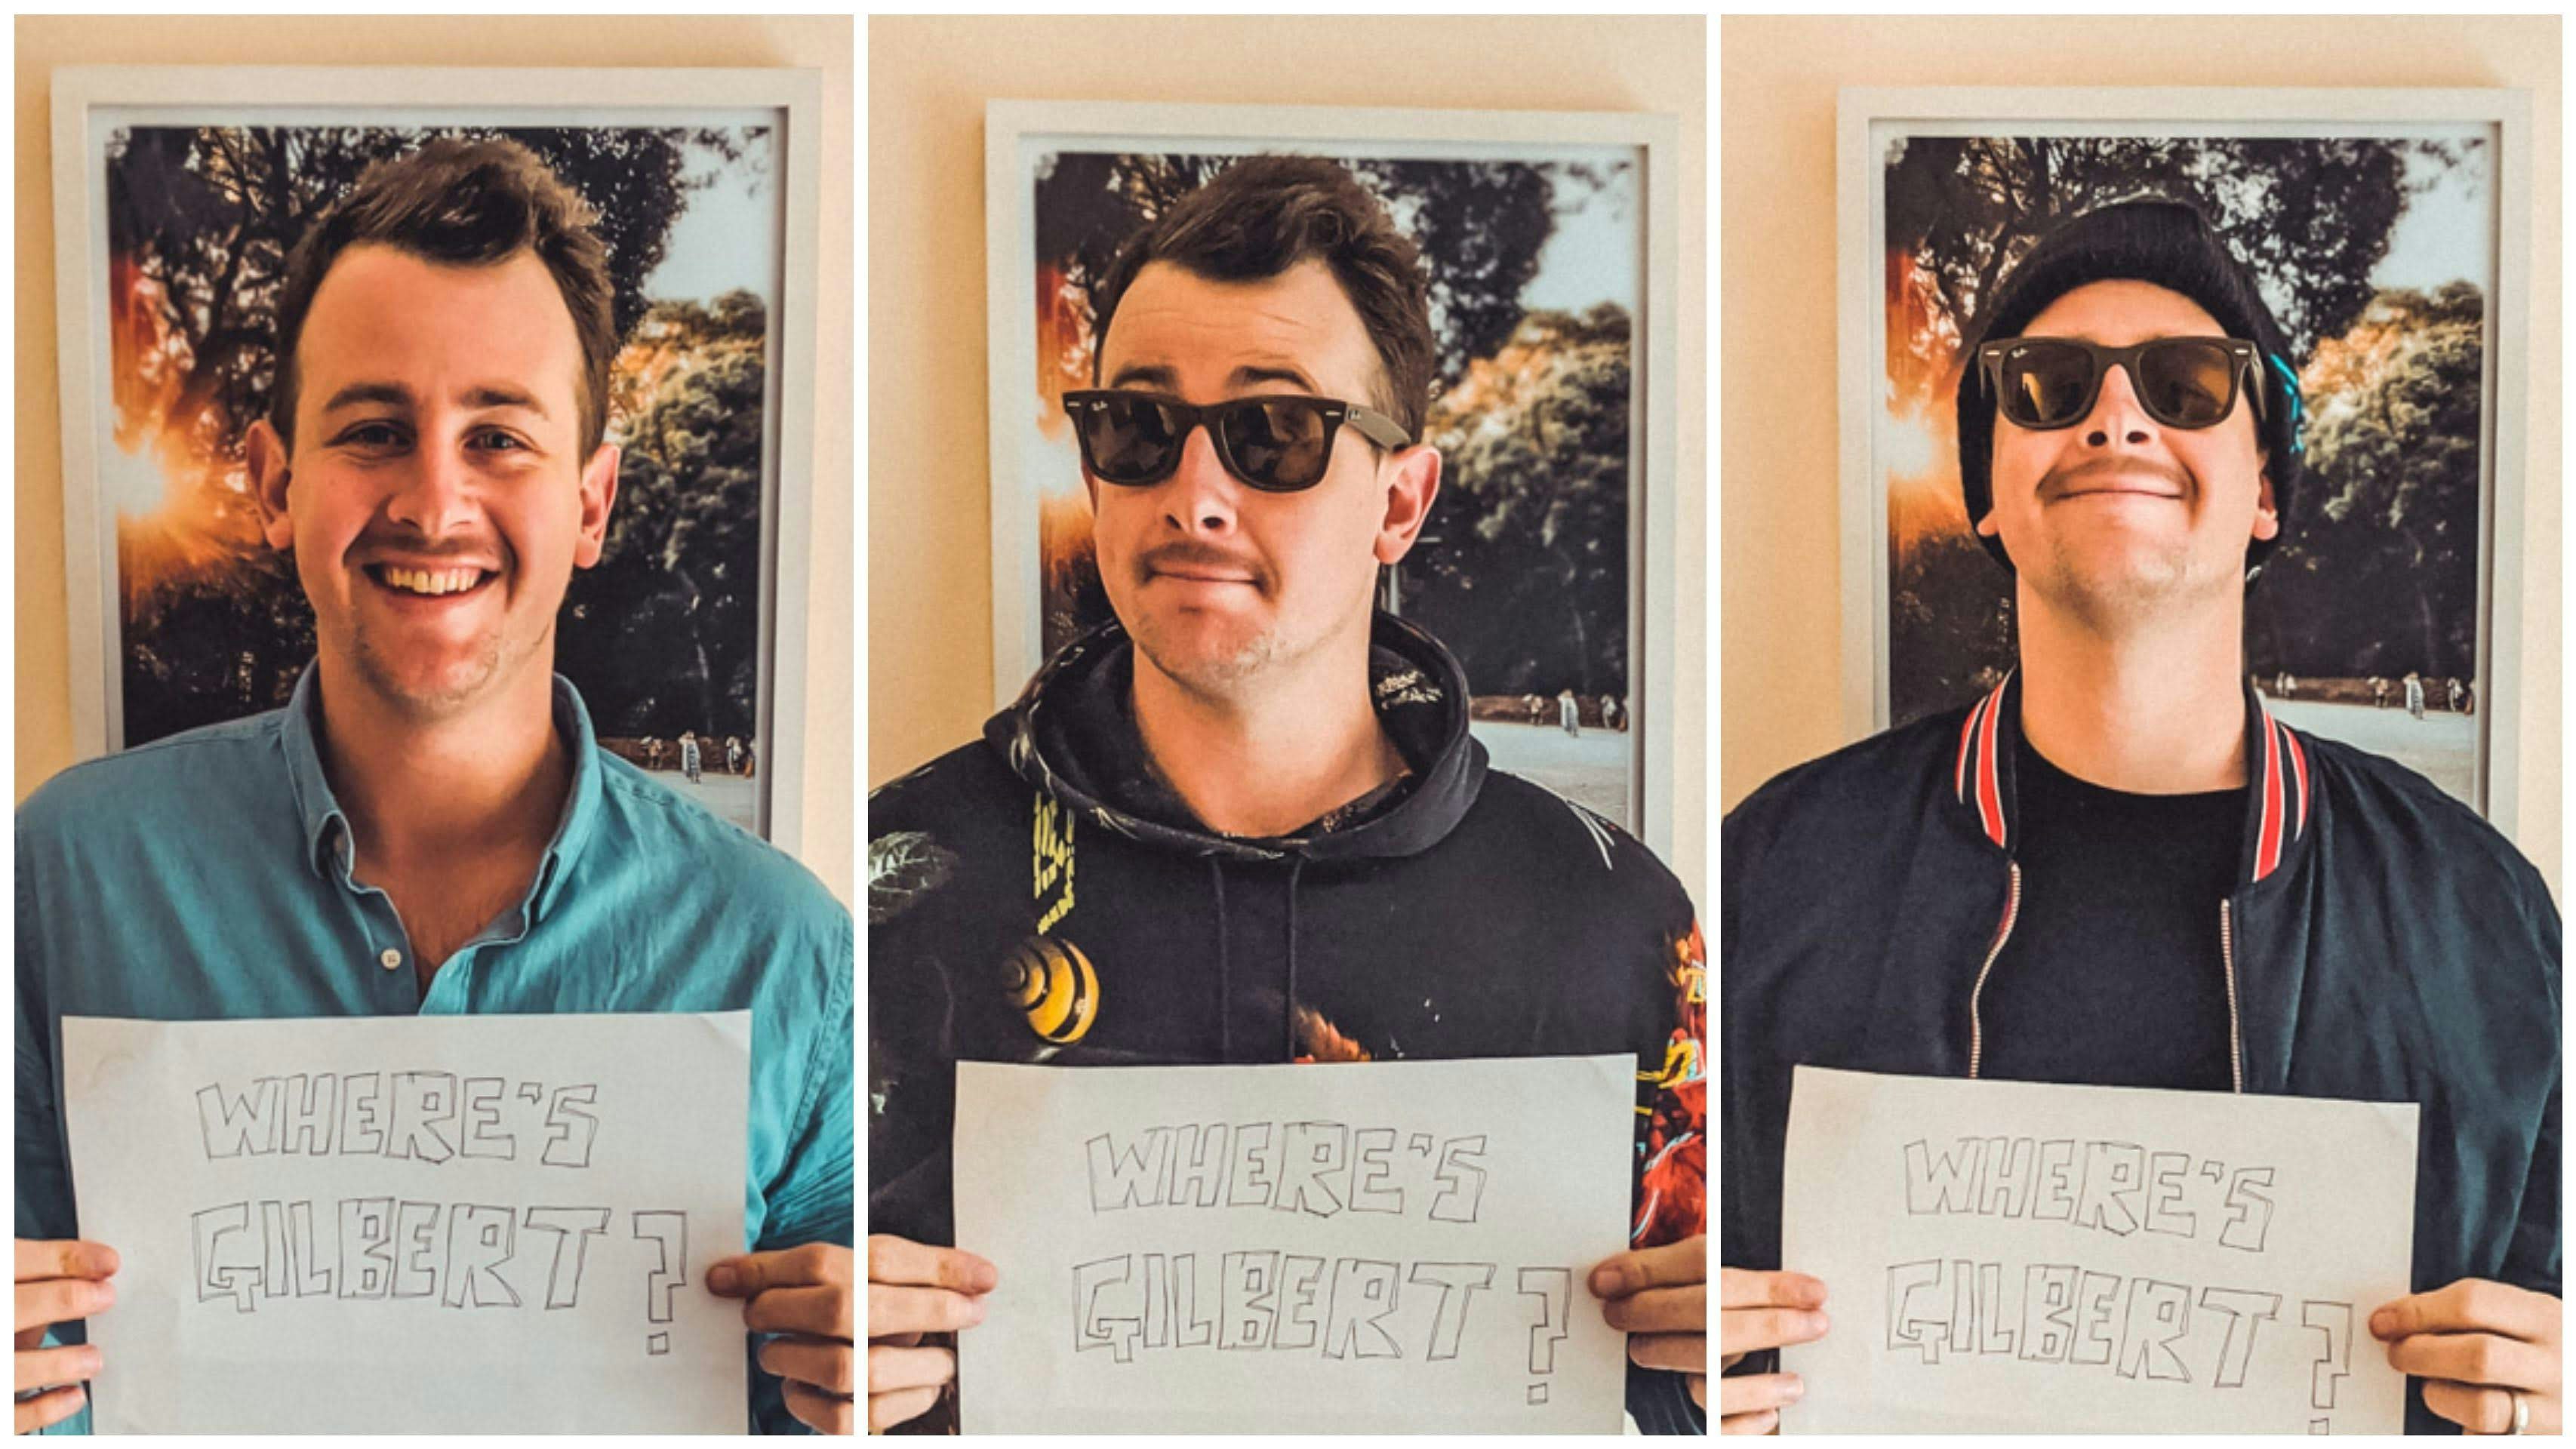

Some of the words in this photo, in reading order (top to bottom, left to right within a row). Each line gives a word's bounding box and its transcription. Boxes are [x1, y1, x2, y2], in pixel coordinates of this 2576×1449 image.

[195, 1071, 597, 1168] WHERE'S
[1085, 1121, 1487, 1223] WHERE'S
[1904, 1137, 2275, 1252] WHERE'S
